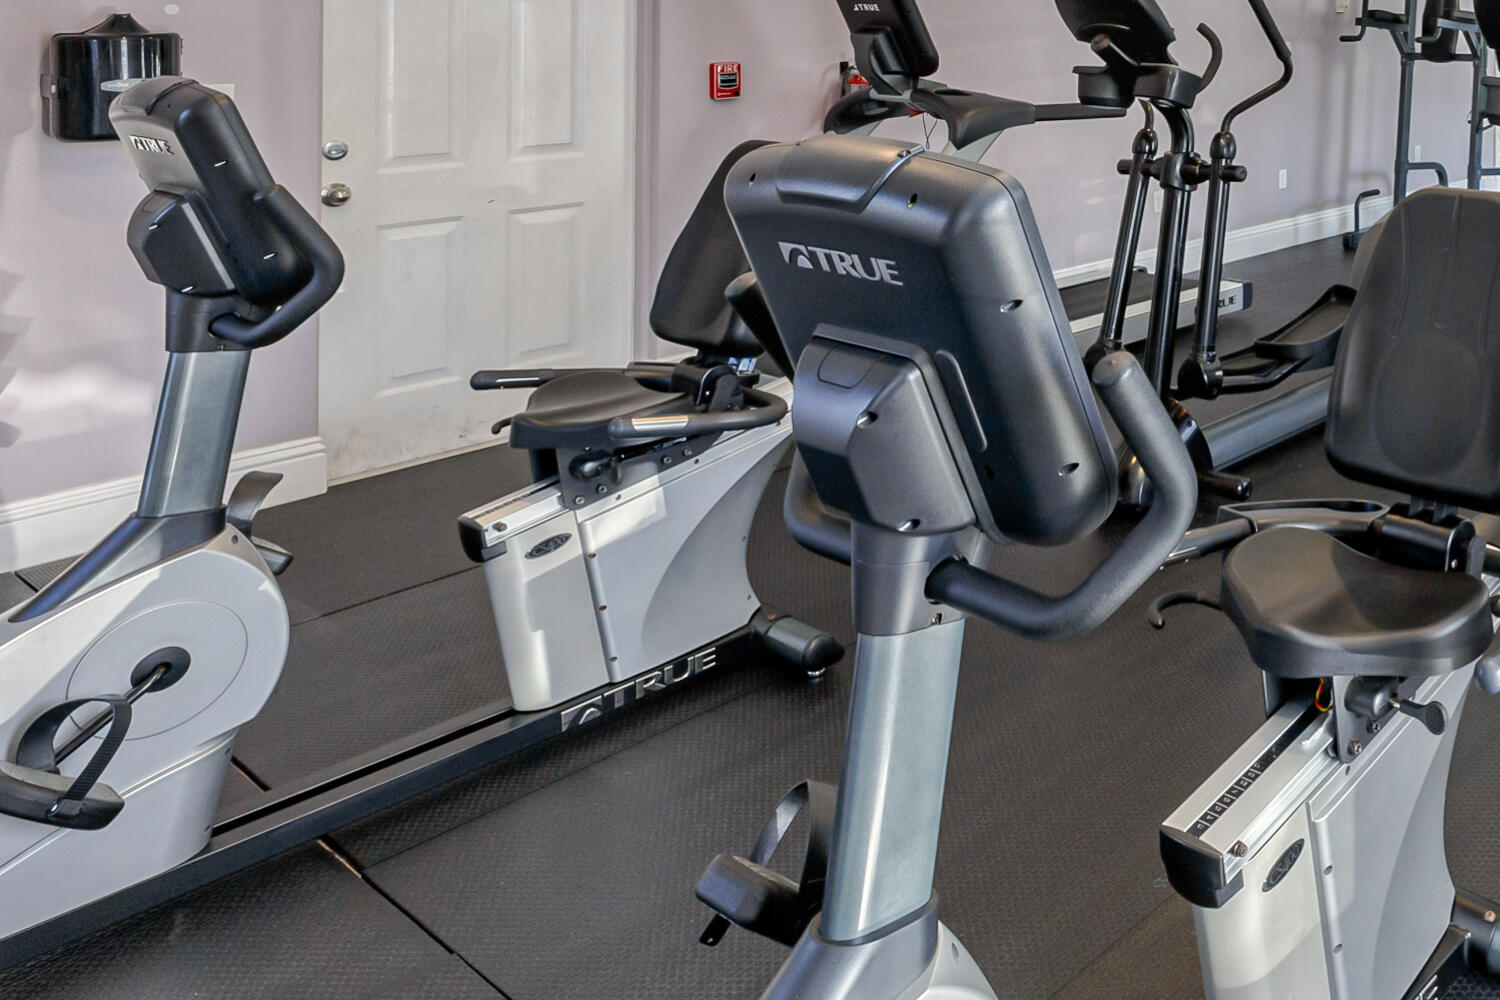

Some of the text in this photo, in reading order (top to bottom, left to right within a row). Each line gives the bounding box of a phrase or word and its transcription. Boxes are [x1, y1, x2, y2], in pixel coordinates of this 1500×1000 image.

[858, 3, 880, 11] TRUE
[717, 64, 738, 72] FIRE
[807, 246, 903, 286] TRUE
[604, 647, 716, 708] TRUE
